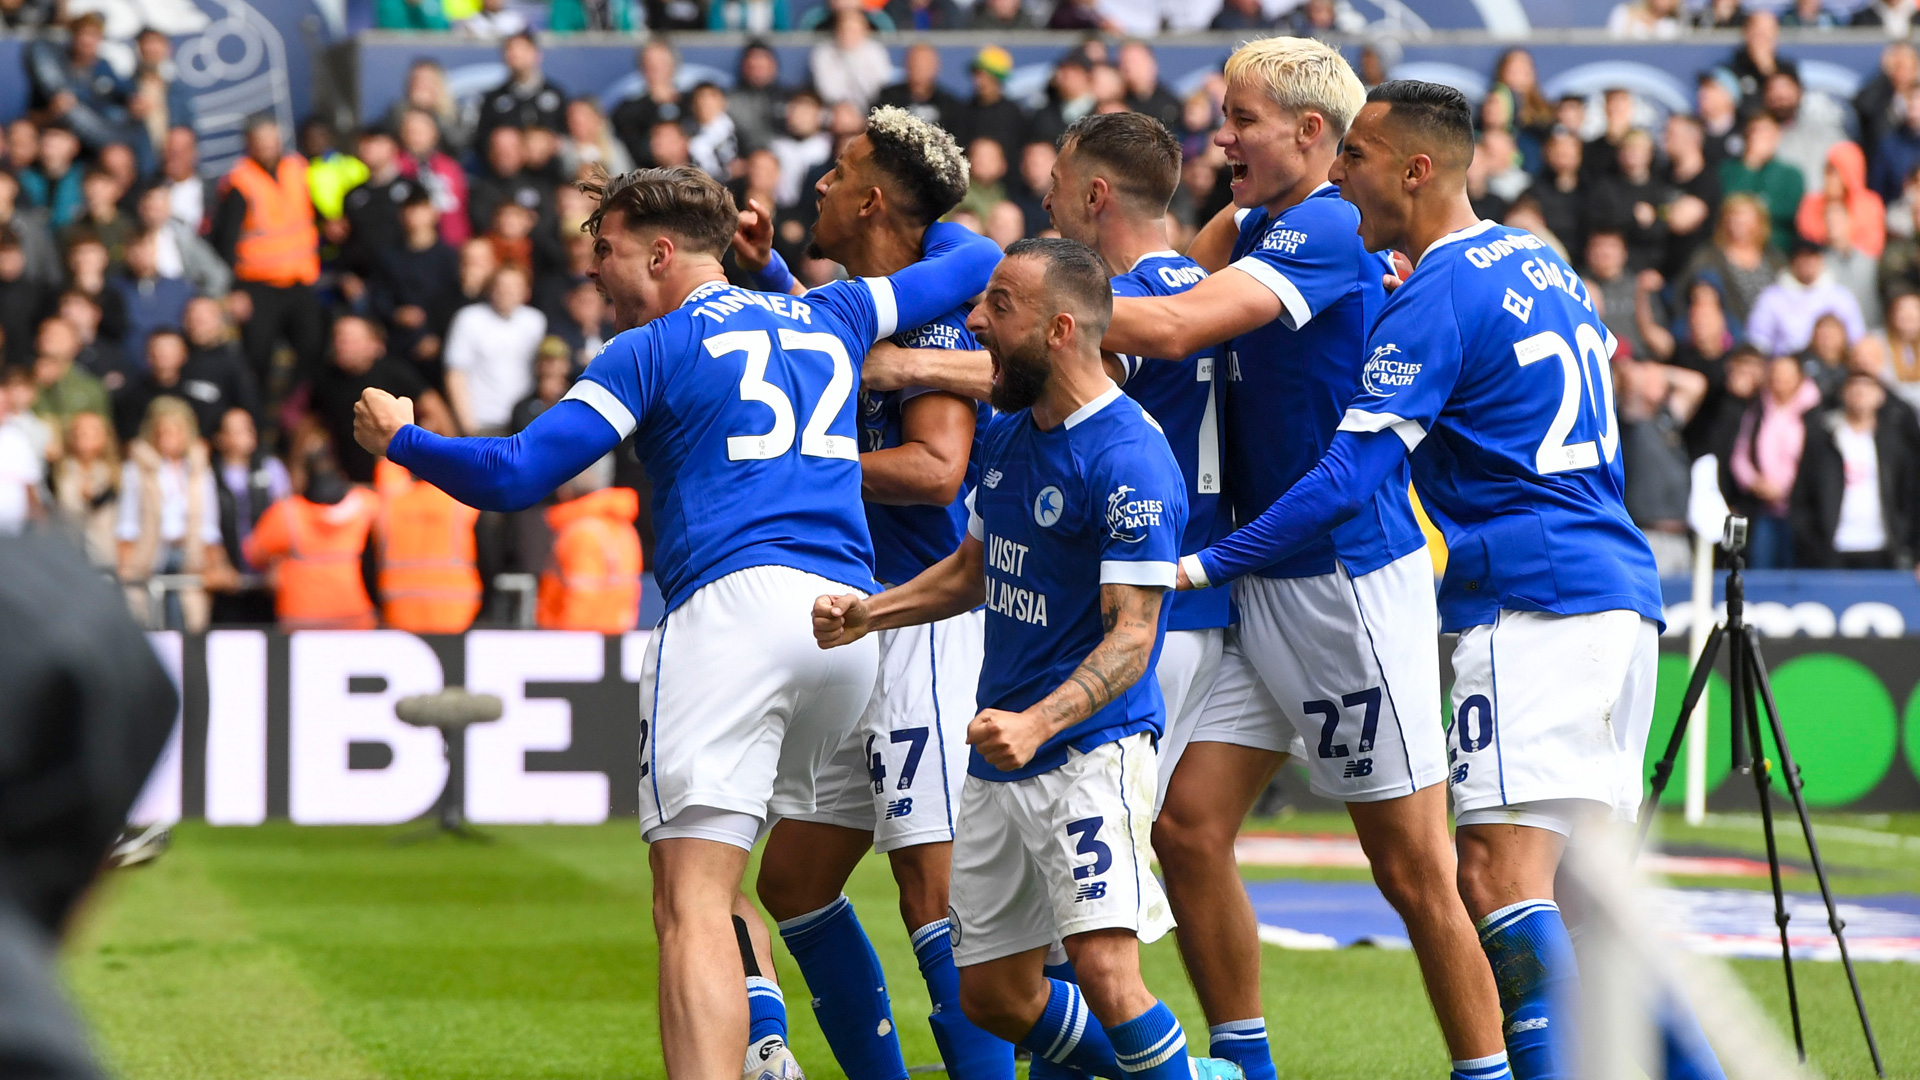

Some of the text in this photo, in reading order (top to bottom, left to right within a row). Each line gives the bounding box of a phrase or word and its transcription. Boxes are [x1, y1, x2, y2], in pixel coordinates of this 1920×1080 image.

[1263, 239, 1299, 254] BATH
[692, 289, 812, 325] TANNER
[1502, 287, 1534, 325] EL
[919, 334, 956, 350] BATH
[702, 328, 859, 462] 32
[1380, 373, 1415, 386] BATH
[1513, 323, 1619, 475] 20
[1124, 513, 1161, 530] BATH
[989, 533, 1029, 577] VISIT
[985, 574, 1048, 628] ALAYSIA
[127, 629, 644, 826] IBE
[1303, 686, 1382, 758] 27
[1066, 815, 1113, 881] 3
